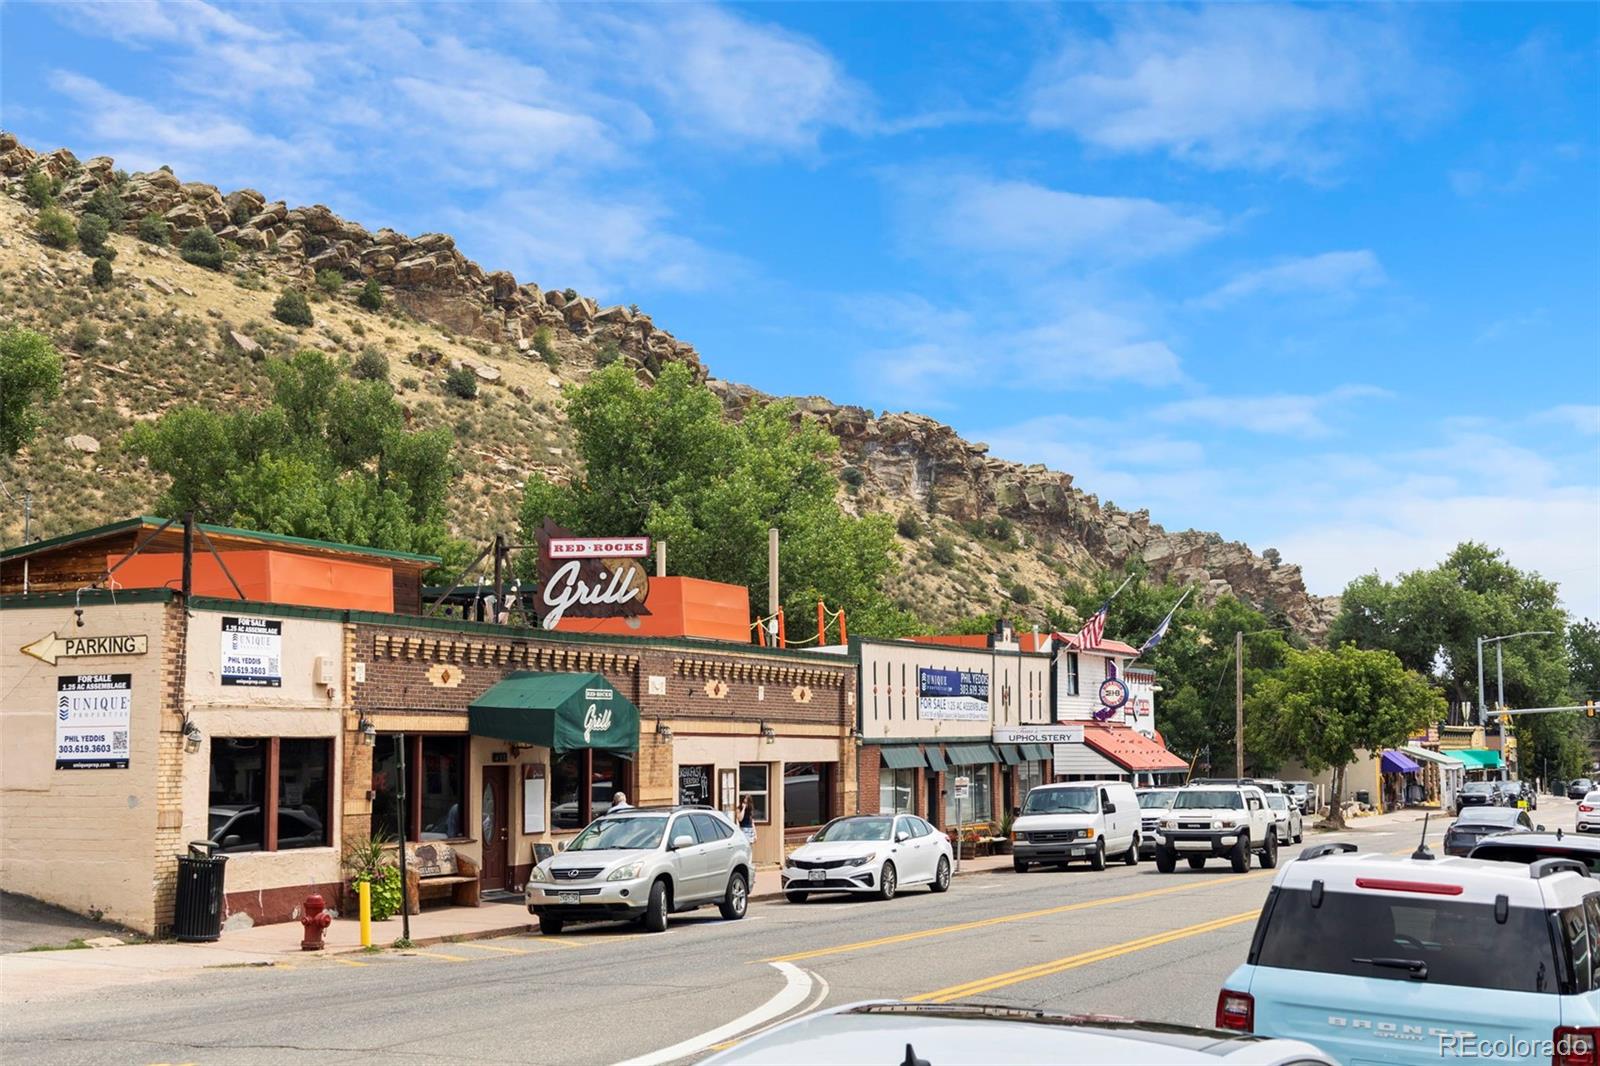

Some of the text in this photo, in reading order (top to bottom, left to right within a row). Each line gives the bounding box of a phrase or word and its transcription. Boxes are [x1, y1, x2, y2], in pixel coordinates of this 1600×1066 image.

[594, 543, 643, 552] ROCKS
[542, 560, 640, 630] Grill
[66, 637, 135, 654] PARKING
[240, 635, 271, 646] UNIQUE
[223, 666, 266, 675] 303.619.3603
[78, 674, 112, 683] FOR SALE
[926, 674, 947, 686] UNIQUE
[961, 673, 988, 684] PHIL YEDDIS
[73, 697, 127, 711] UNIQUE
[921, 697, 932, 709] FOR
[934, 698, 946, 710] SALE
[584, 704, 612, 743] Grill
[59, 744, 111, 753] 303.619.3603
